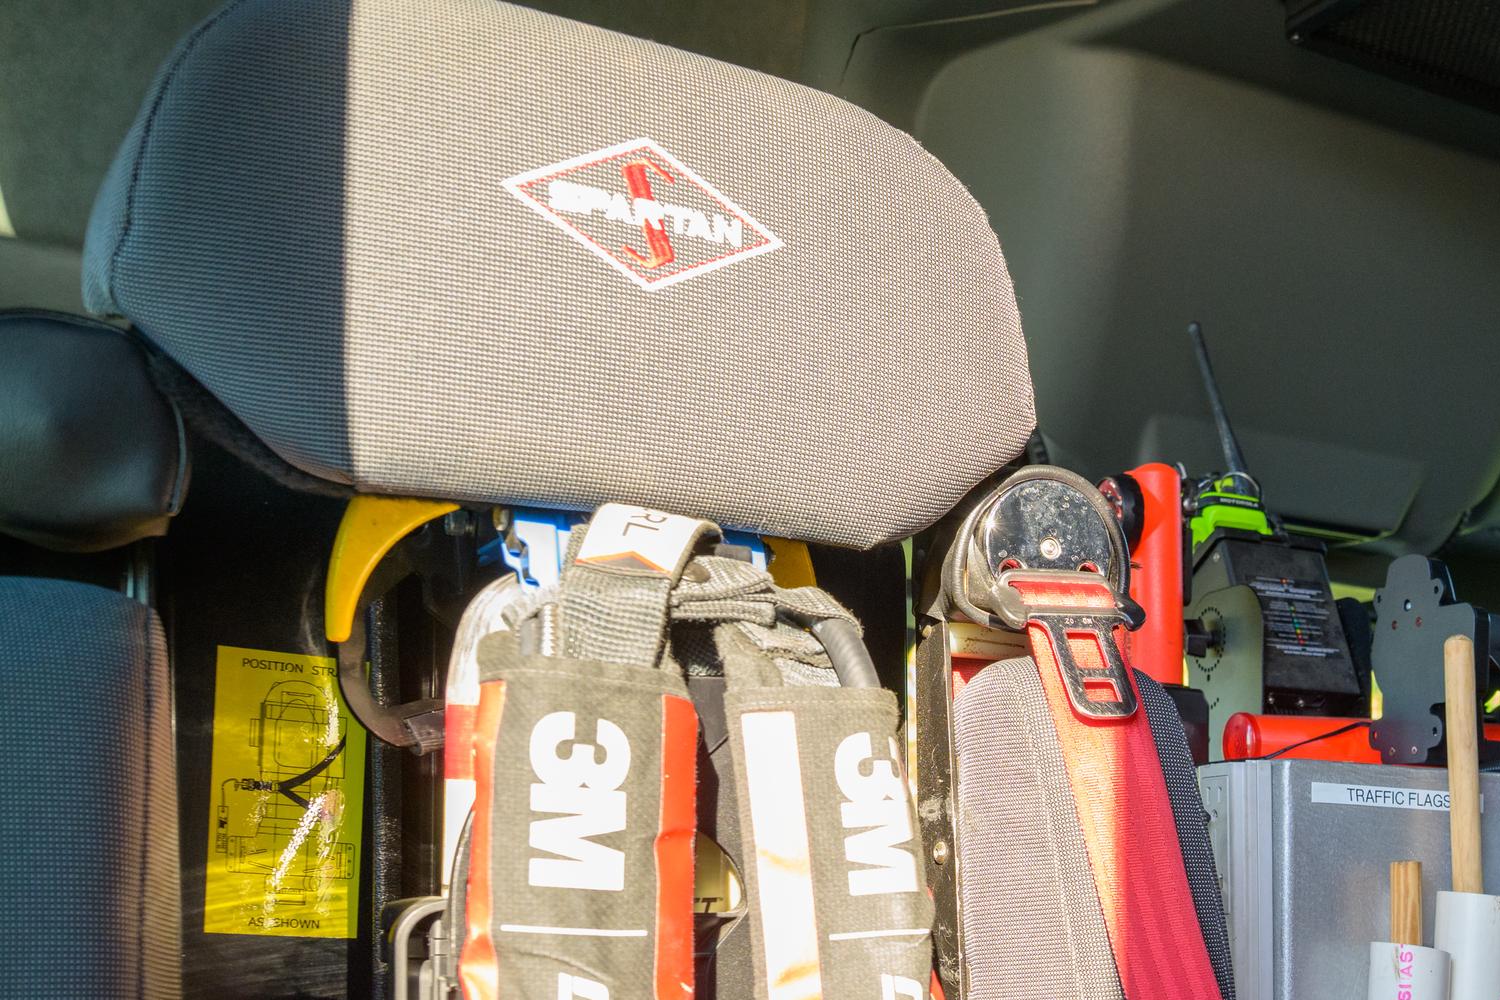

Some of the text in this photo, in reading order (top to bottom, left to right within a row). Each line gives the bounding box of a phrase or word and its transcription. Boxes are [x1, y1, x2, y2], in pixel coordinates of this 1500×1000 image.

[547, 178, 743, 248] SPARTAN
[242, 658, 338, 677] POSITION STR
[528, 710, 632, 891] 3M
[834, 731, 919, 896] 3M
[1346, 788, 1450, 809] TRAFFIC FLAGS
[247, 917, 264, 927] AS
[1398, 943, 1414, 978] AS
